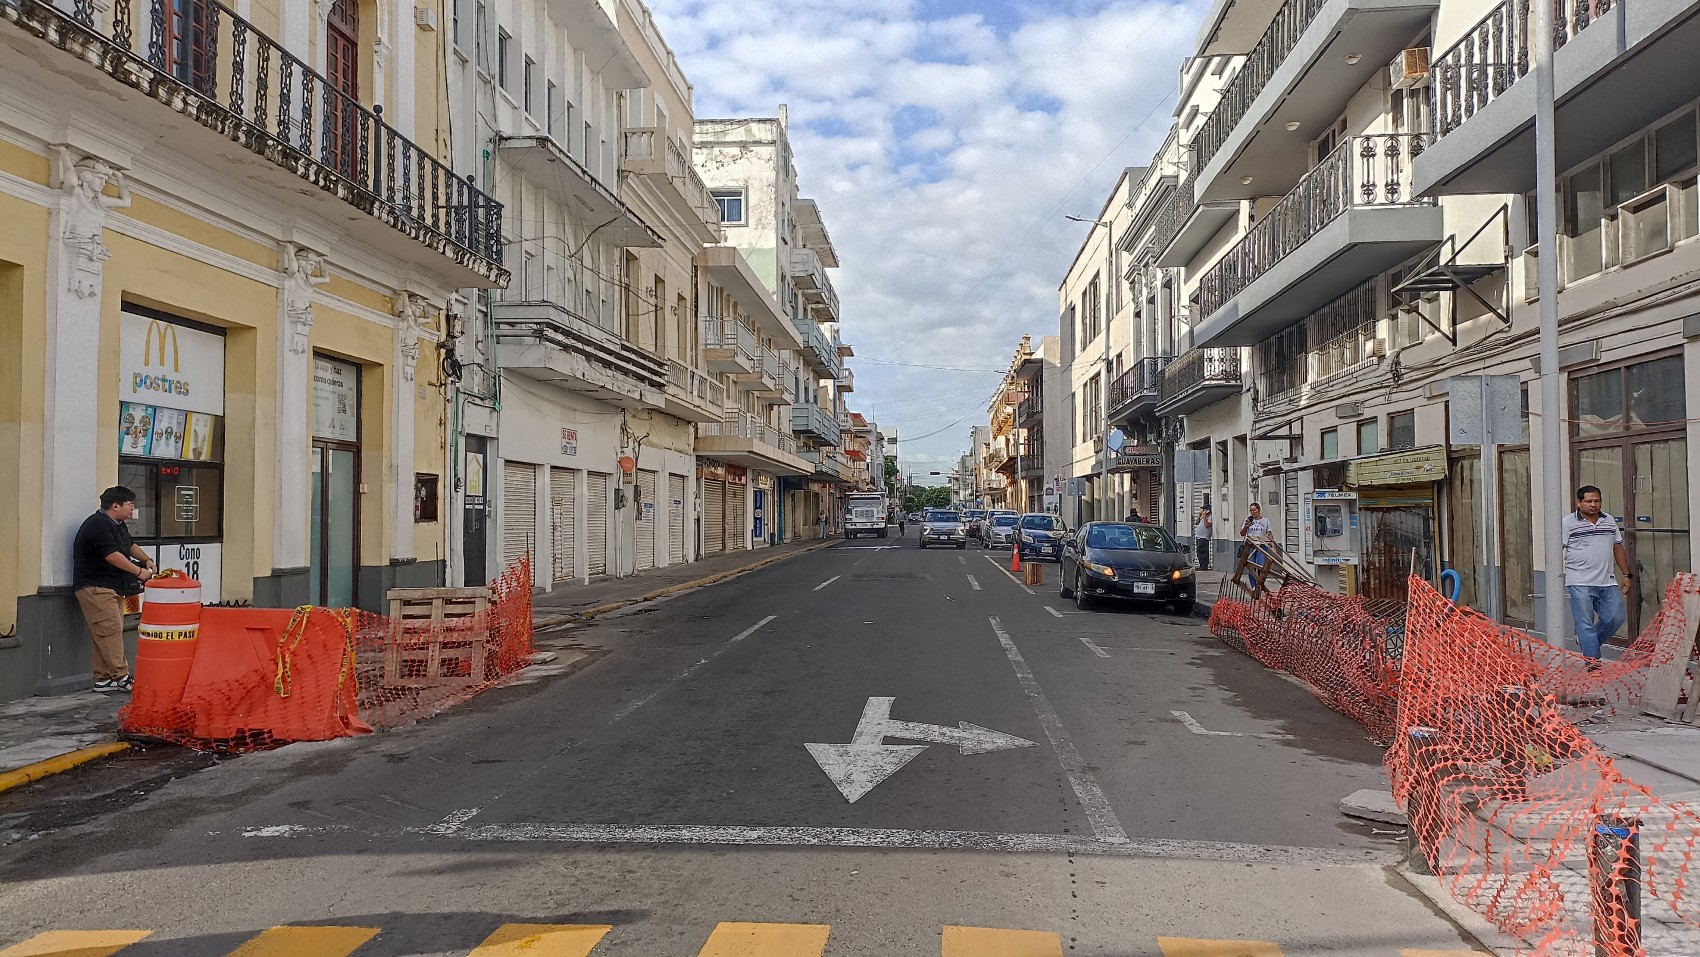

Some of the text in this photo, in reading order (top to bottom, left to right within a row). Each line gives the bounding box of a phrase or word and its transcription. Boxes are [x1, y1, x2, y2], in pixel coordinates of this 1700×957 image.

[132, 372, 190, 396] postres
[1117, 457, 1160, 466] GUAYABERAS
[179, 544, 200, 560] Cono
[185, 561, 199, 580] 18
[166, 631, 175, 640] EL
